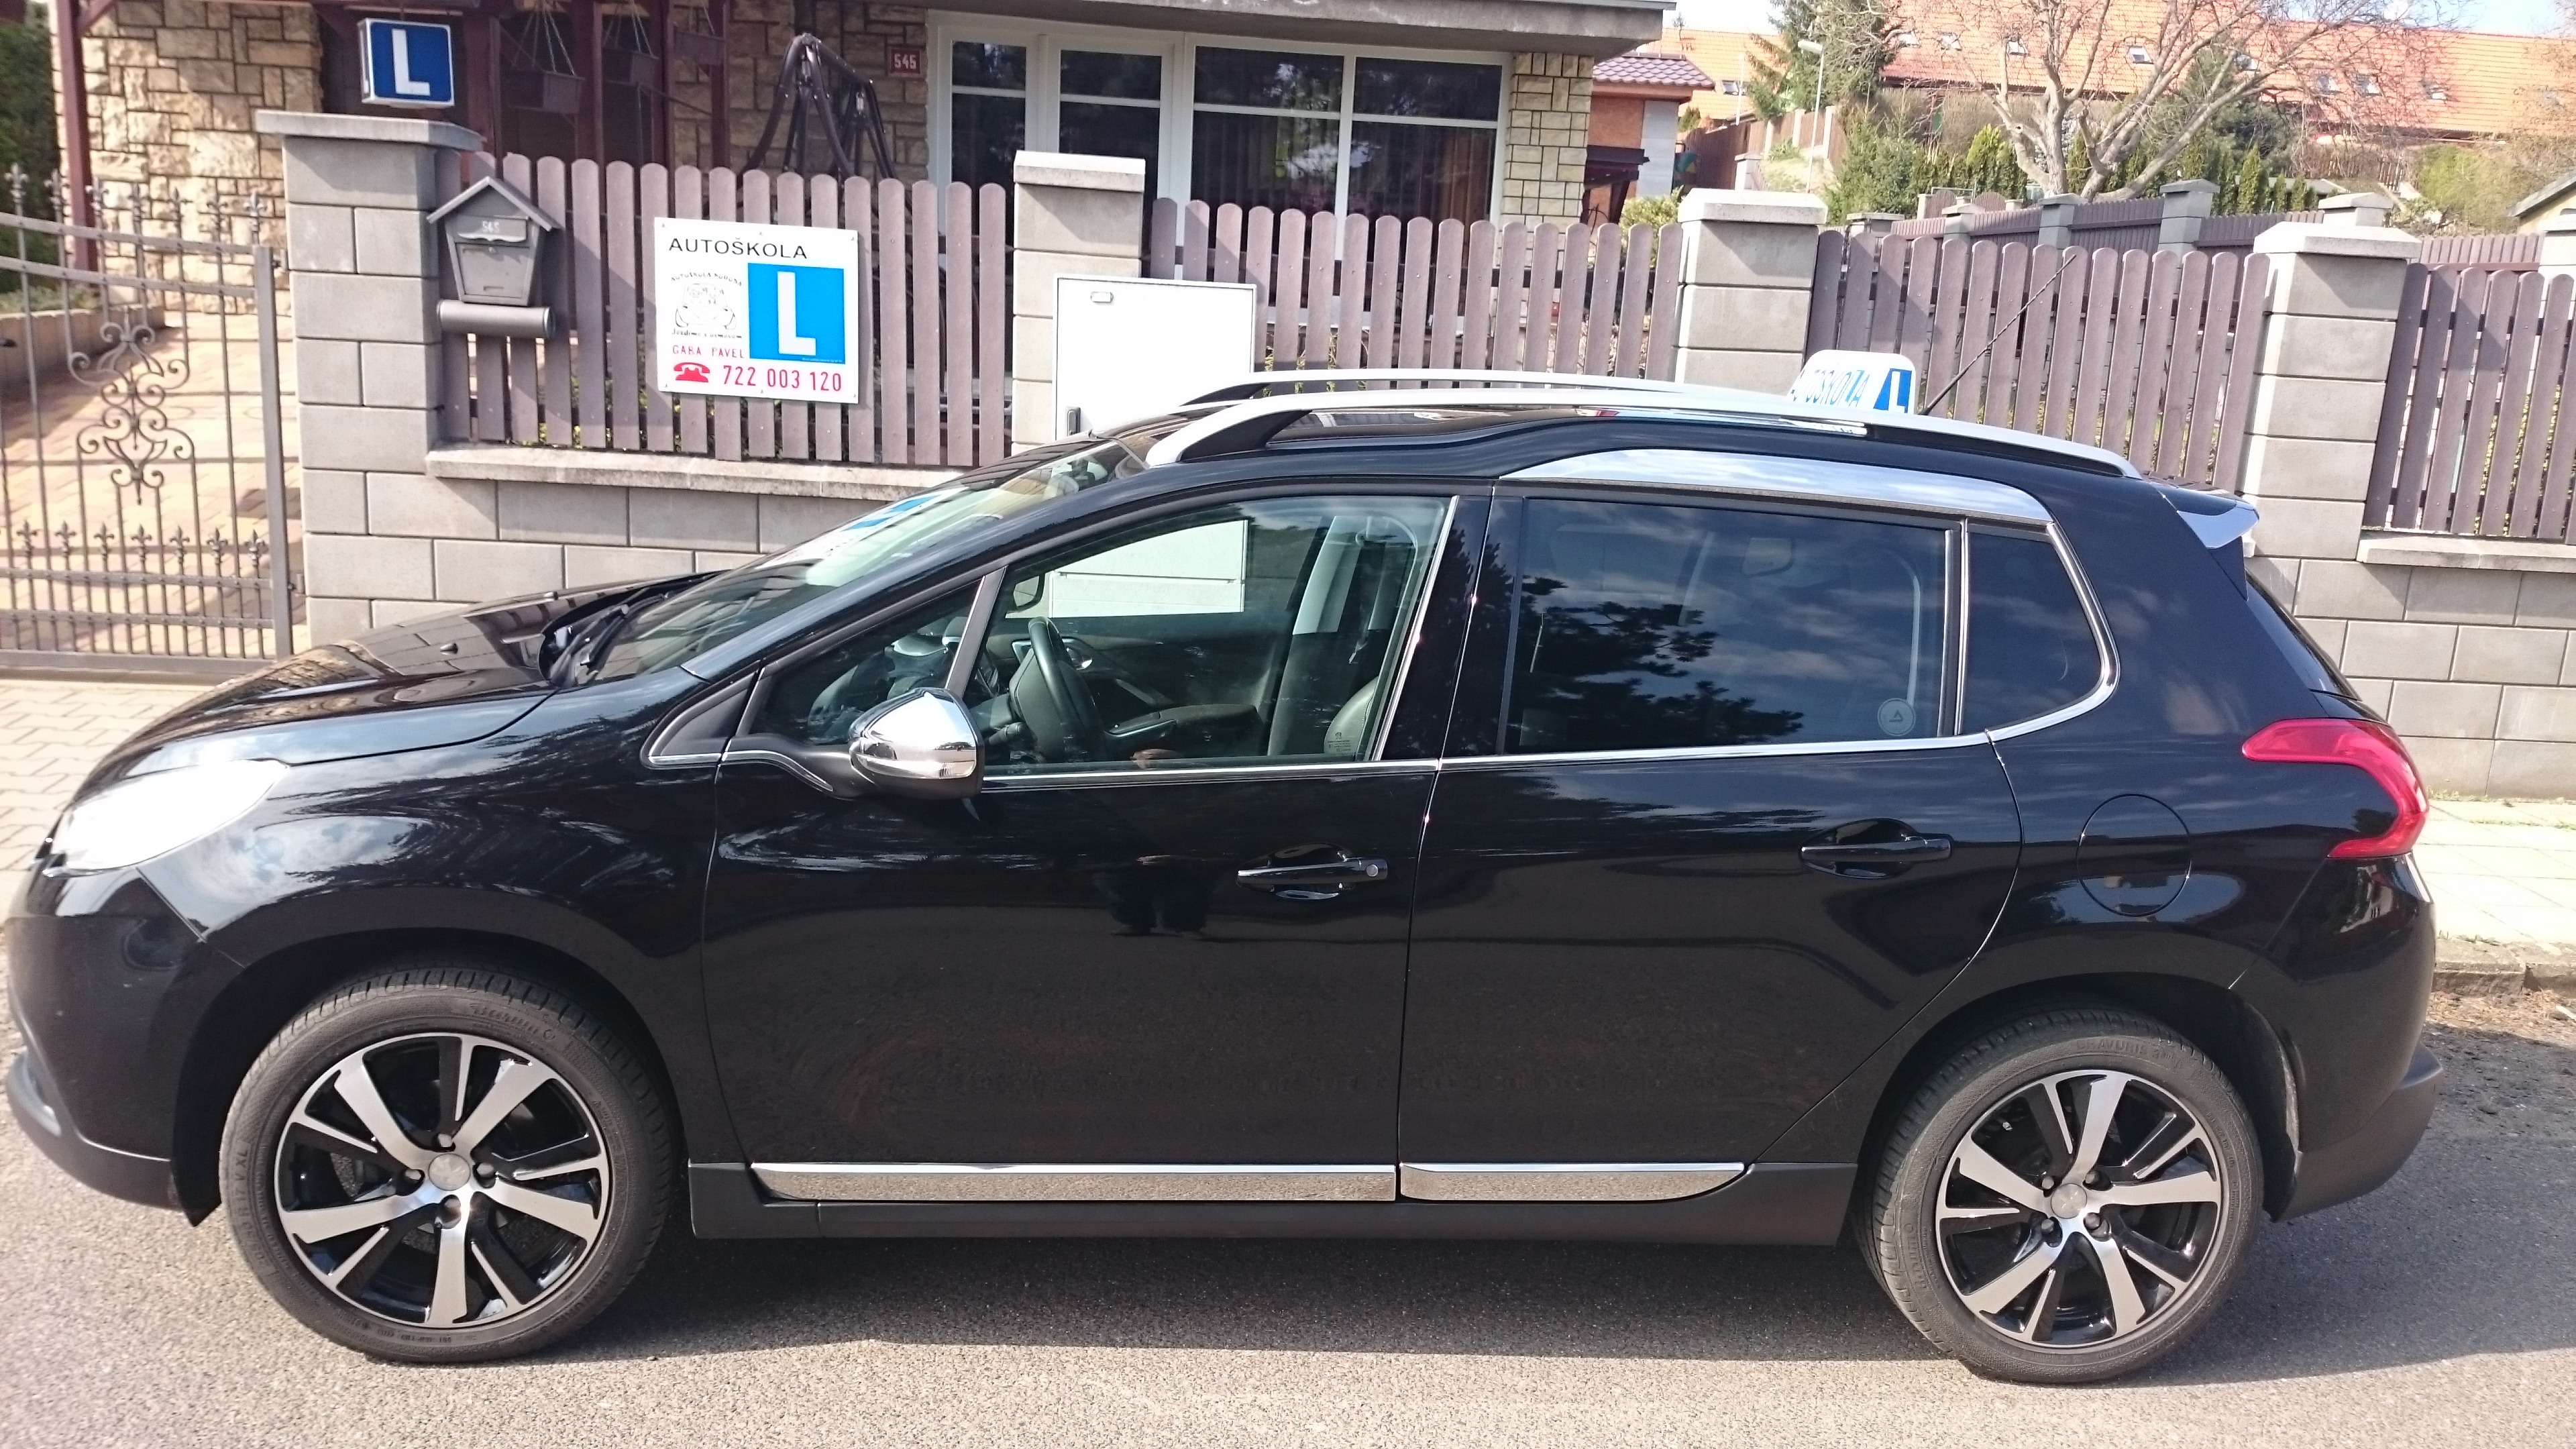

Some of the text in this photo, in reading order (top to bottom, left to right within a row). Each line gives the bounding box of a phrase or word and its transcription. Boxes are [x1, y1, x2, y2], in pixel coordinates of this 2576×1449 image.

[392, 28, 430, 96] L
[894, 54, 917, 69] 545
[668, 237, 808, 260] AUTOŠKOLA
[777, 271, 816, 356] L
[672, 345, 745, 359] GABA PAVEL
[723, 365, 842, 392] 722 003 120
[235, 1149, 248, 1169] XL
